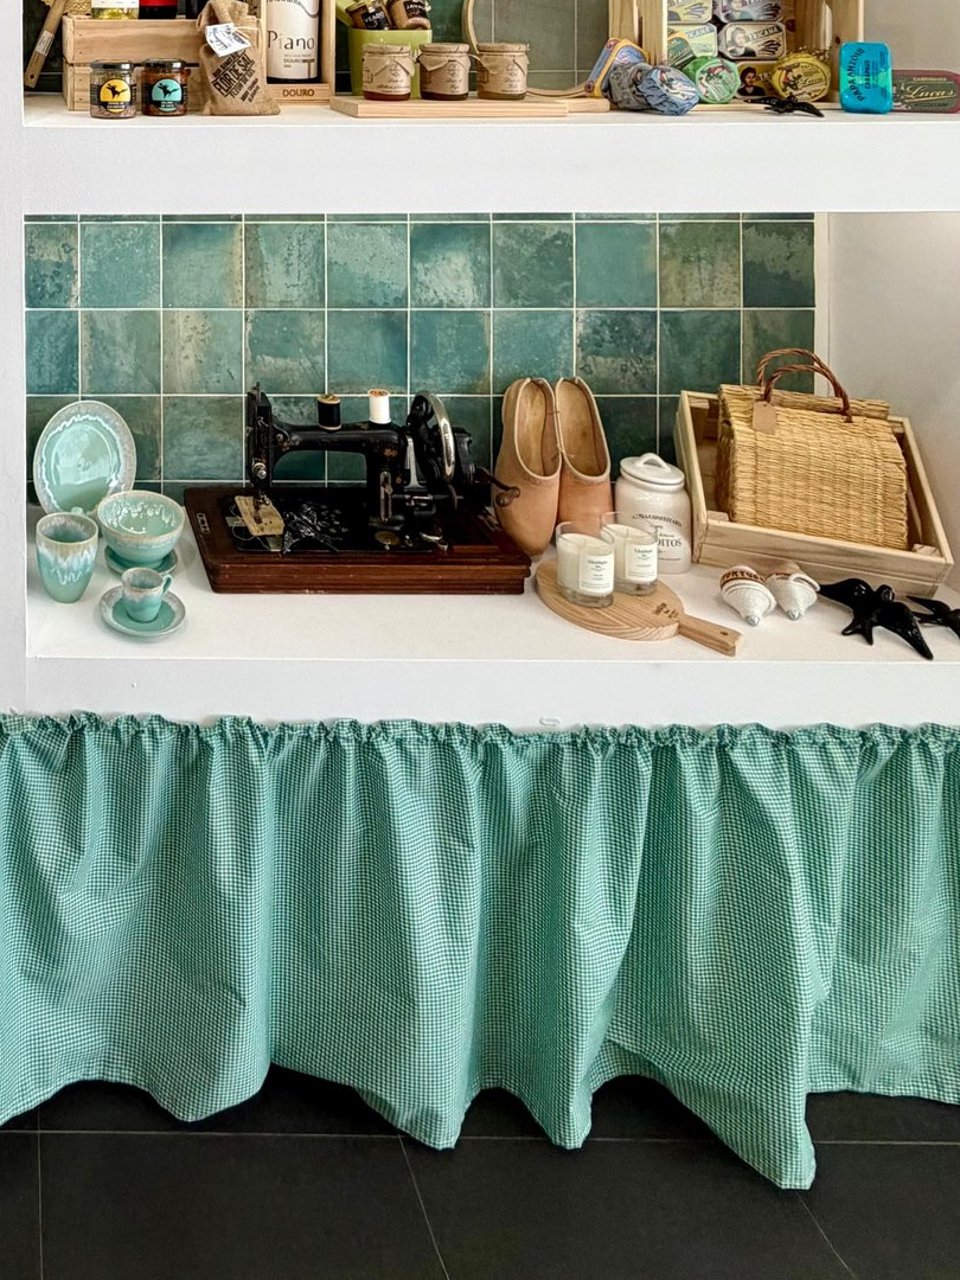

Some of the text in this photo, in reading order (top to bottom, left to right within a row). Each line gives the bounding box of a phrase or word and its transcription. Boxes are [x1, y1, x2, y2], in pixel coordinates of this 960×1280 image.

[267, 30, 315, 50] Piano
[212, 54, 256, 96] FLOR DE SAL
[283, 89, 314, 97] DOURO
[905, 84, 954, 99] Lucas
